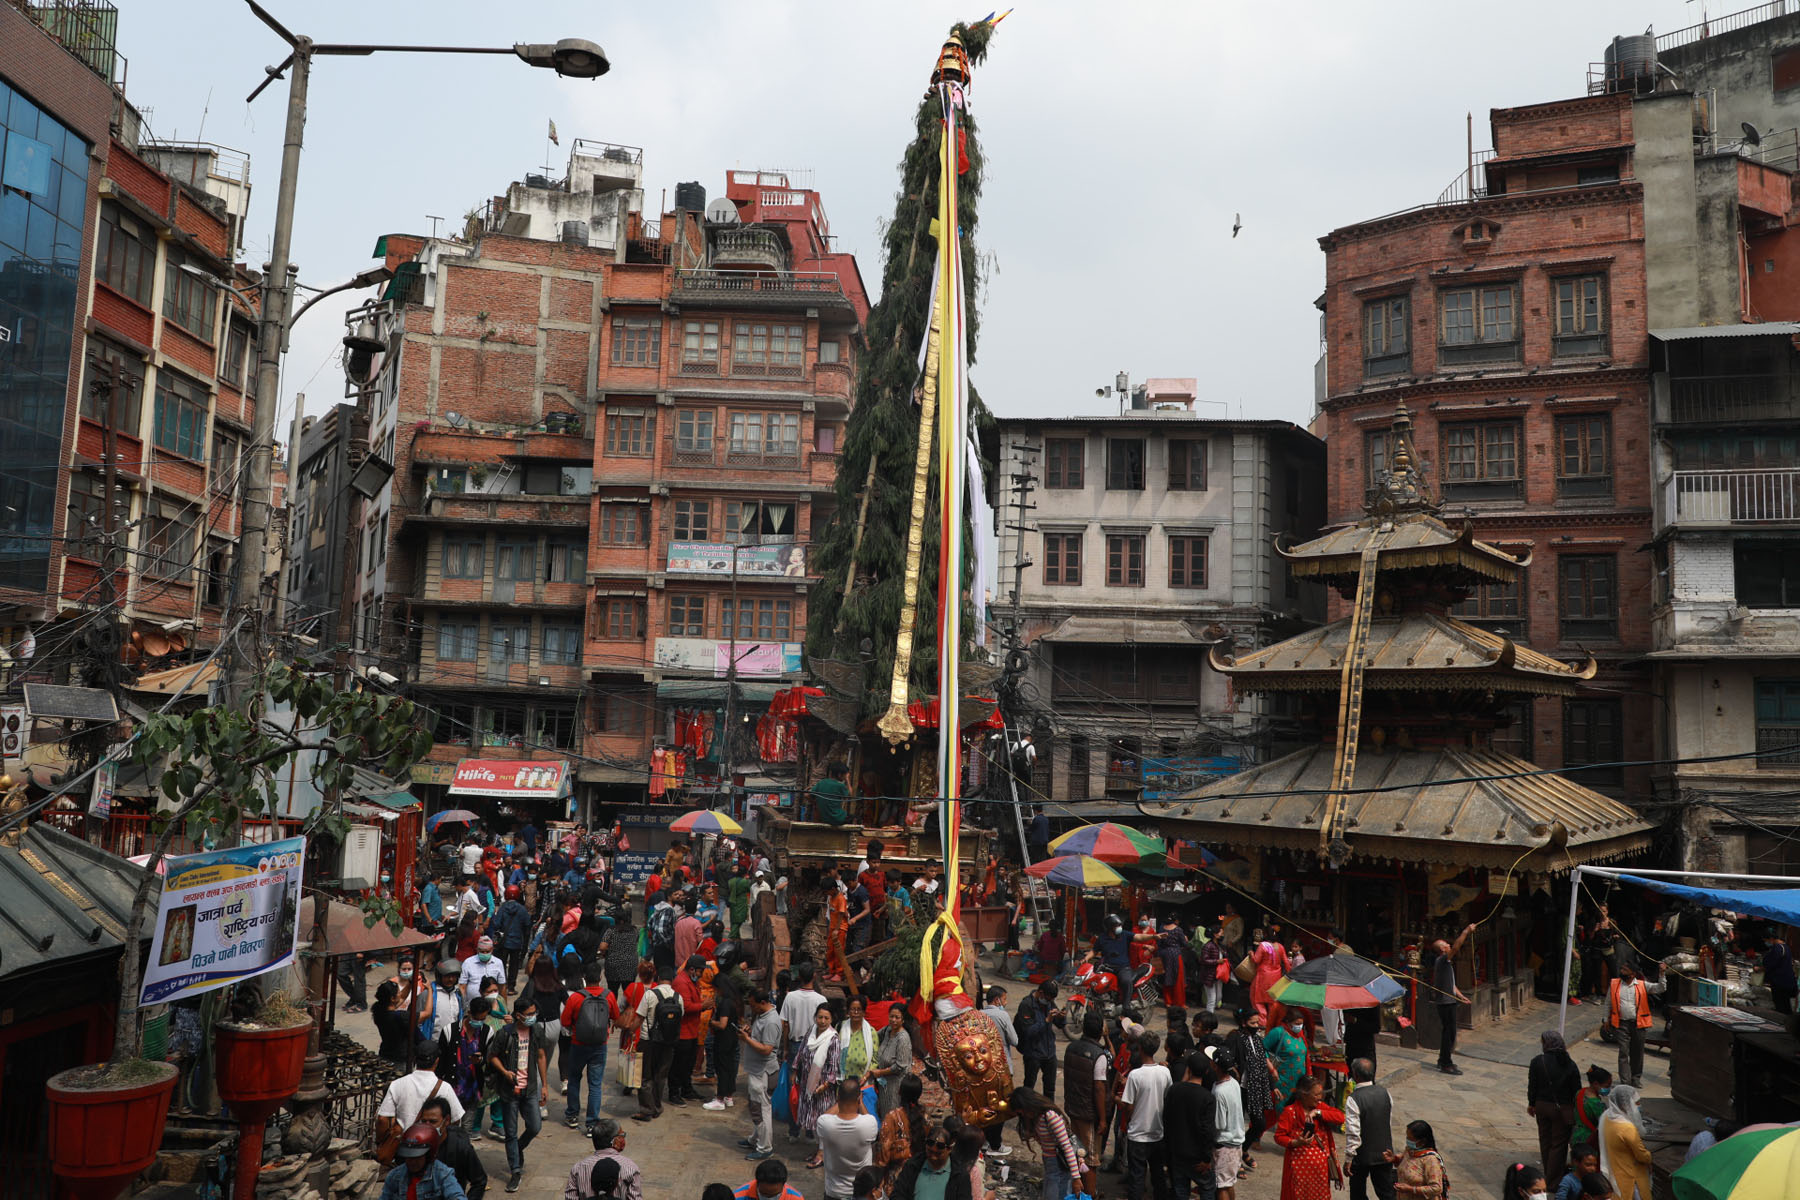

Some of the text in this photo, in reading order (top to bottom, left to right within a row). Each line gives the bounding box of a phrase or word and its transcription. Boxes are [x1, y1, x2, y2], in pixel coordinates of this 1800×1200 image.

[198, 899, 243, 922] जात्रा पर्व
[259, 908, 276, 925] गर्व
[192, 939, 265, 969] पिउने पानी वितरण
